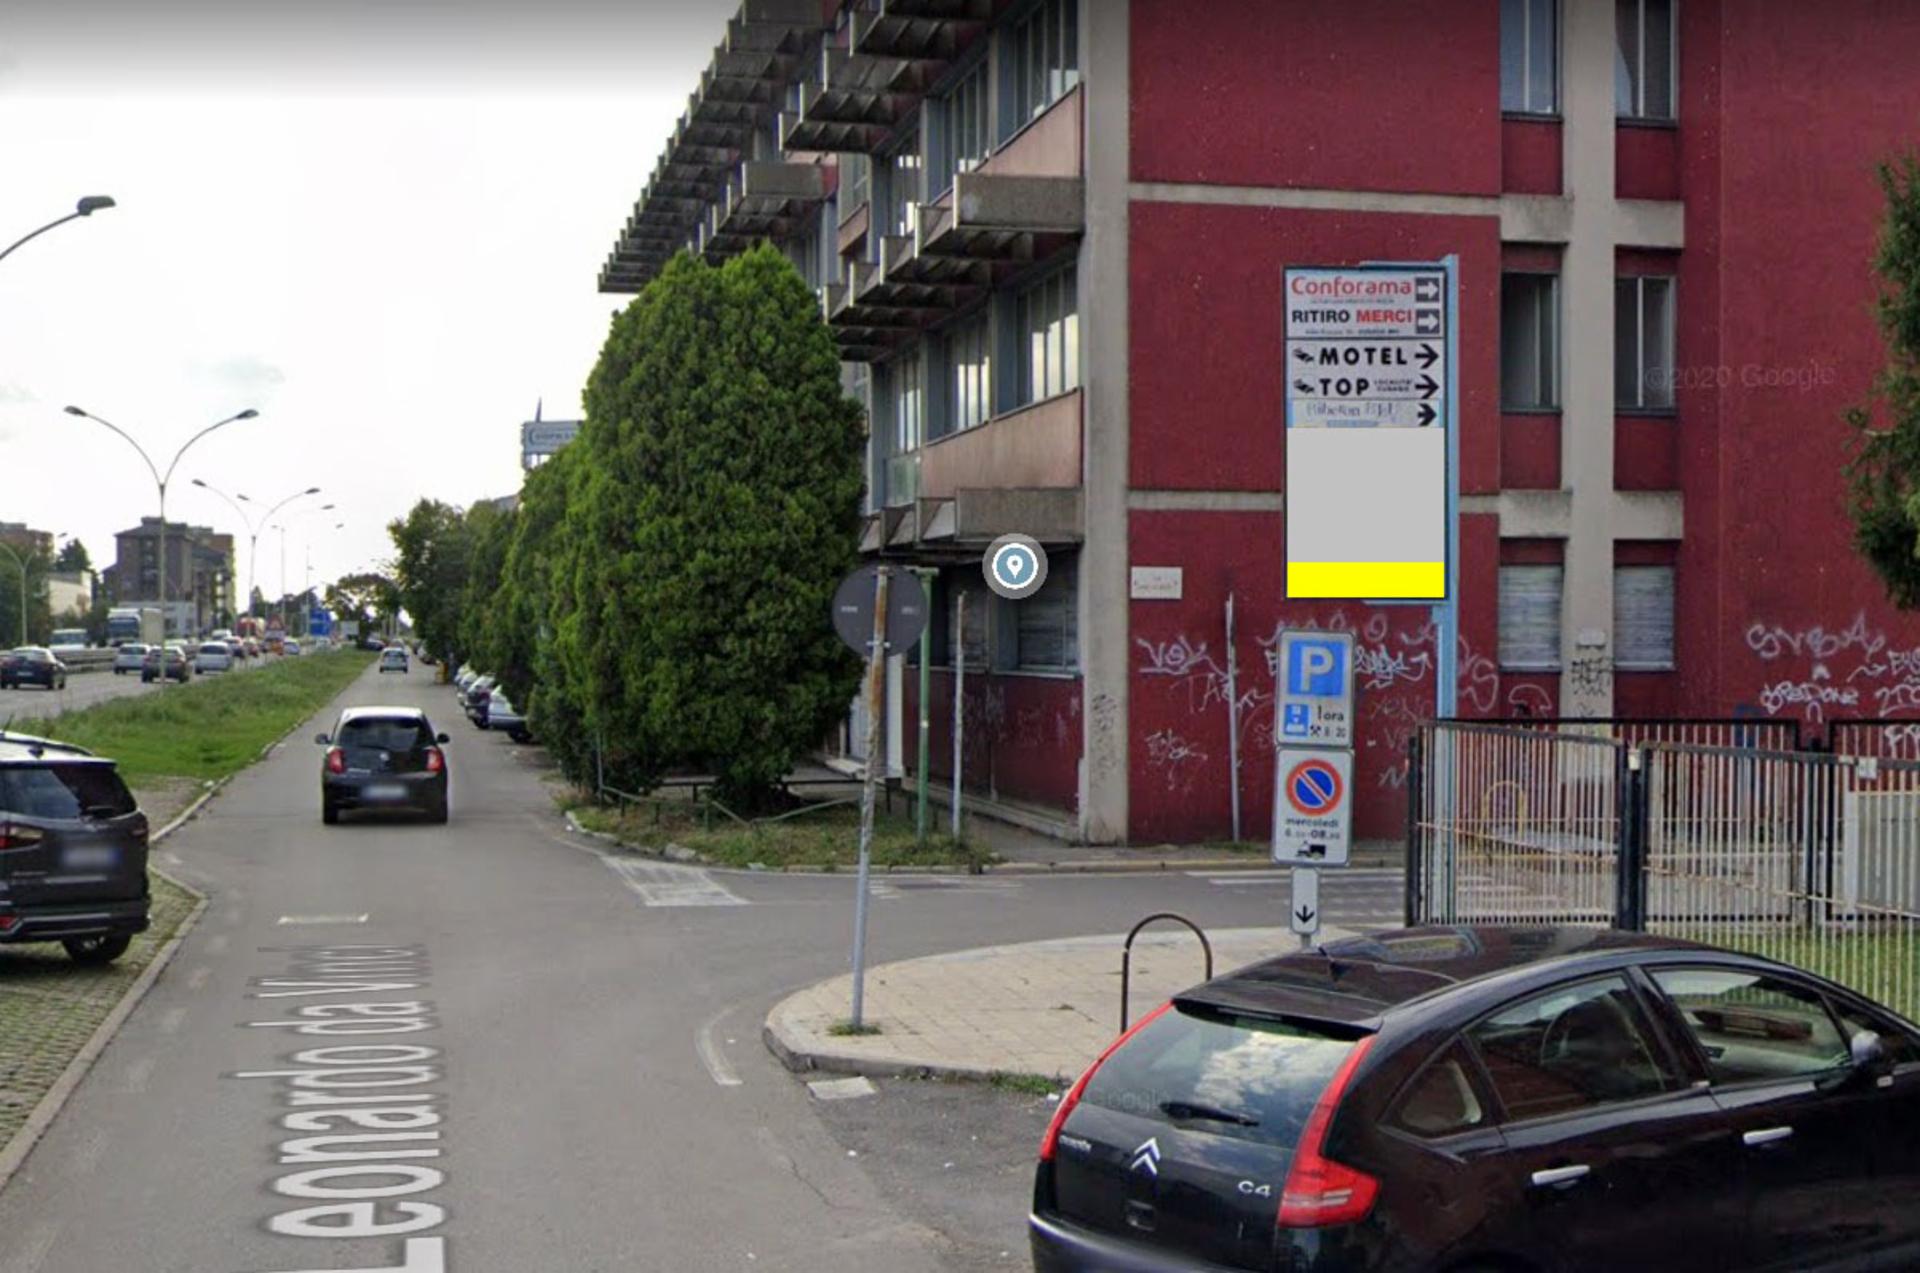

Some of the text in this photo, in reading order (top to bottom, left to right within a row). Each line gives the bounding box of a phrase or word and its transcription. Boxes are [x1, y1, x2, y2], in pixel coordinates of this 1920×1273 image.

[1291, 276, 1412, 297] Conforama
[1292, 310, 1411, 323] RITIRO MERCI
[1319, 347, 1407, 366] MOTEL
[1319, 378, 1369, 396] TOP
[1302, 648, 1334, 692] P
[1238, 1180, 1271, 1197] C4
